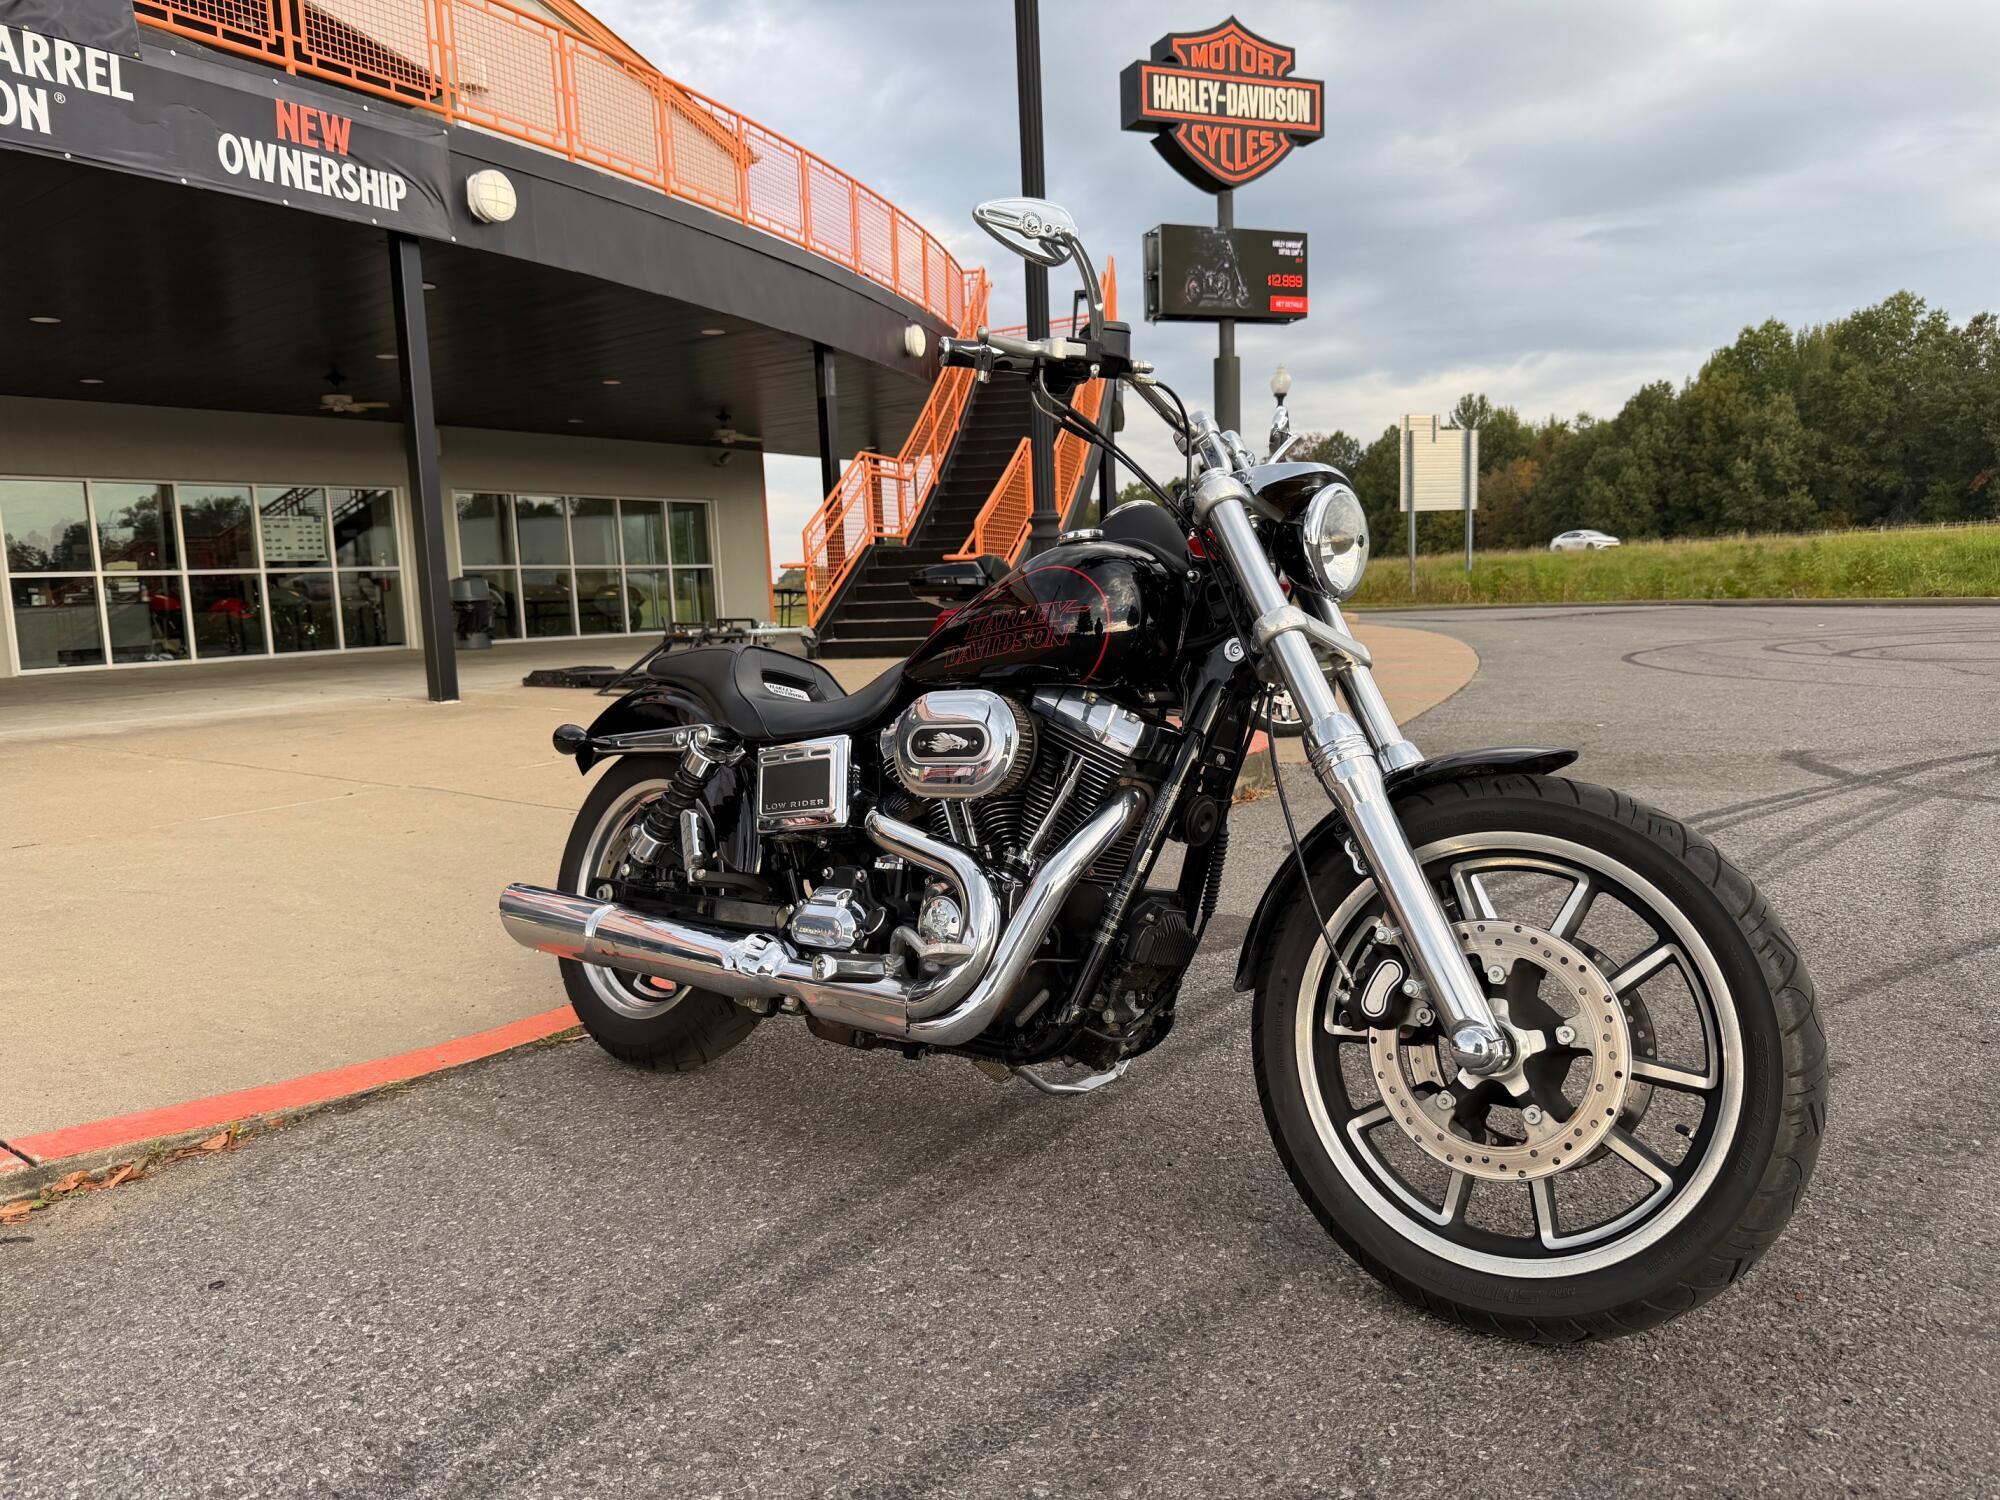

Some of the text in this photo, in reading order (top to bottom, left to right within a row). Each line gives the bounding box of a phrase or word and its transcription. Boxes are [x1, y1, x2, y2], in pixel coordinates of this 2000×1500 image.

[1190, 33, 1275, 77] MOTOR
[1152, 73, 1311, 124] HARLEY-DAVIDSON
[275, 98, 352, 156] NEW
[1191, 124, 1275, 172] CYCLES
[217, 132, 407, 212] OWNERSHIP
[943, 622, 1075, 668] DAVIDSON
[765, 798, 824, 811] LOW RIDER
